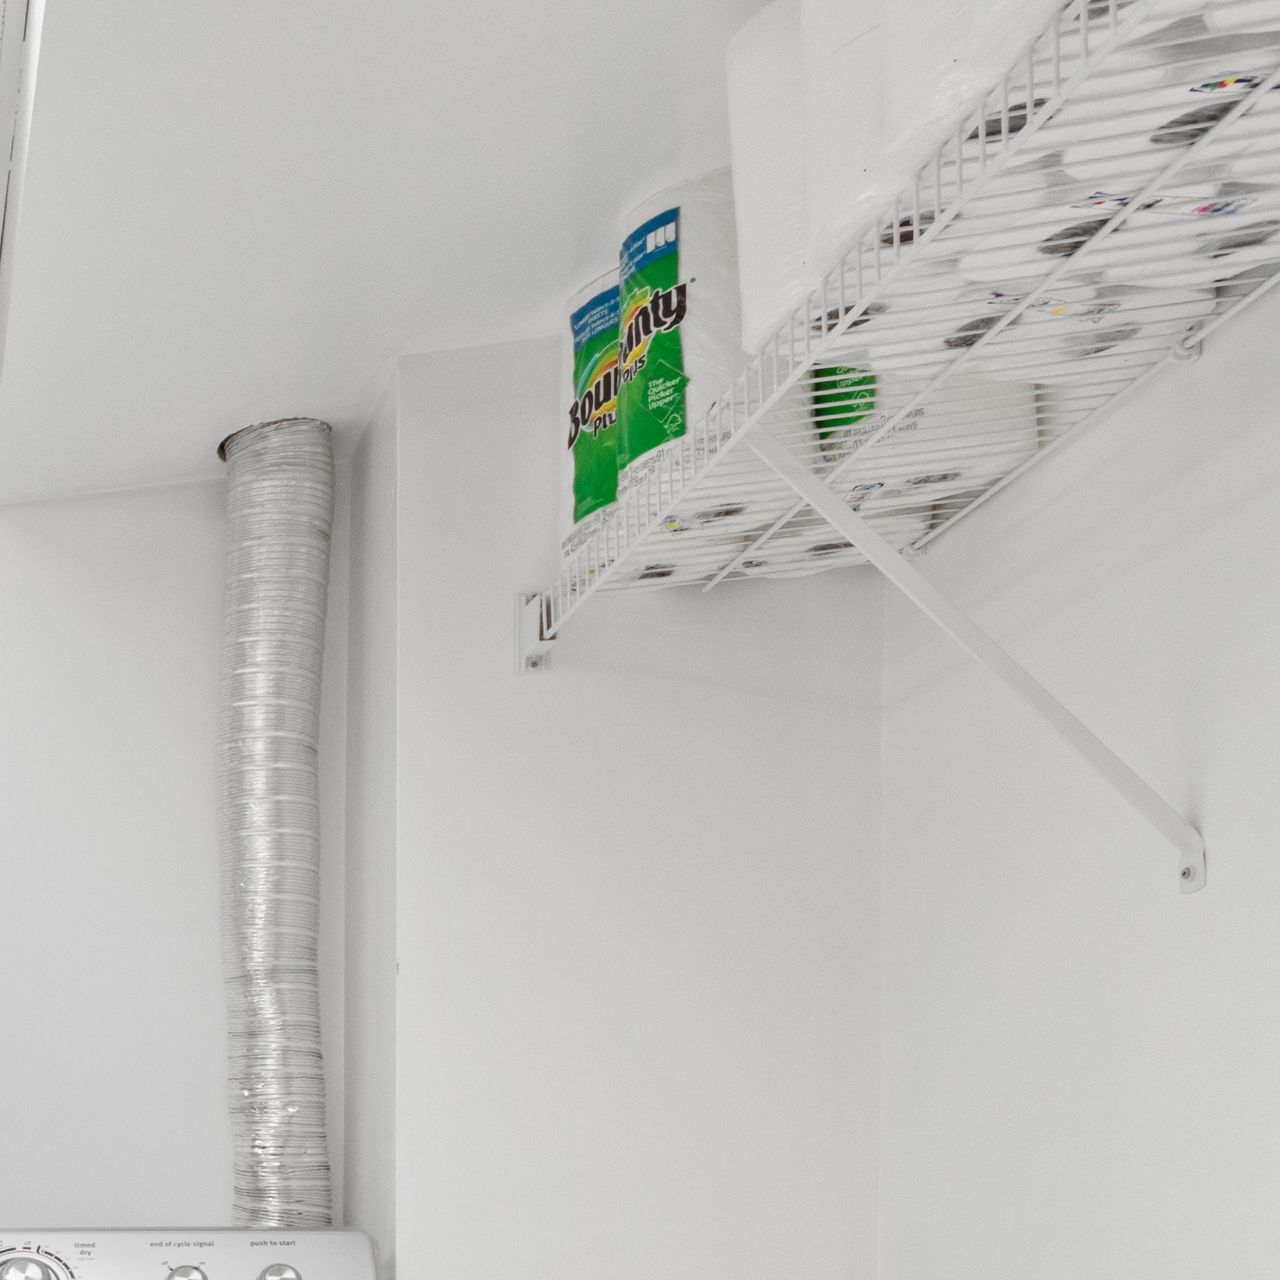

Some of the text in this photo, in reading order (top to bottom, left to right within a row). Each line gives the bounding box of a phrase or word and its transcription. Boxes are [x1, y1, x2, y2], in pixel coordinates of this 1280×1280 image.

[619, 284, 687, 363] unty
[648, 377, 681, 395] Quicker
[648, 387, 674, 403] Picker
[173, 1240, 191, 1248] cycle
[192, 1240, 216, 1248] signal
[250, 1240, 268, 1248] push
[80, 1249, 92, 1257] dry
